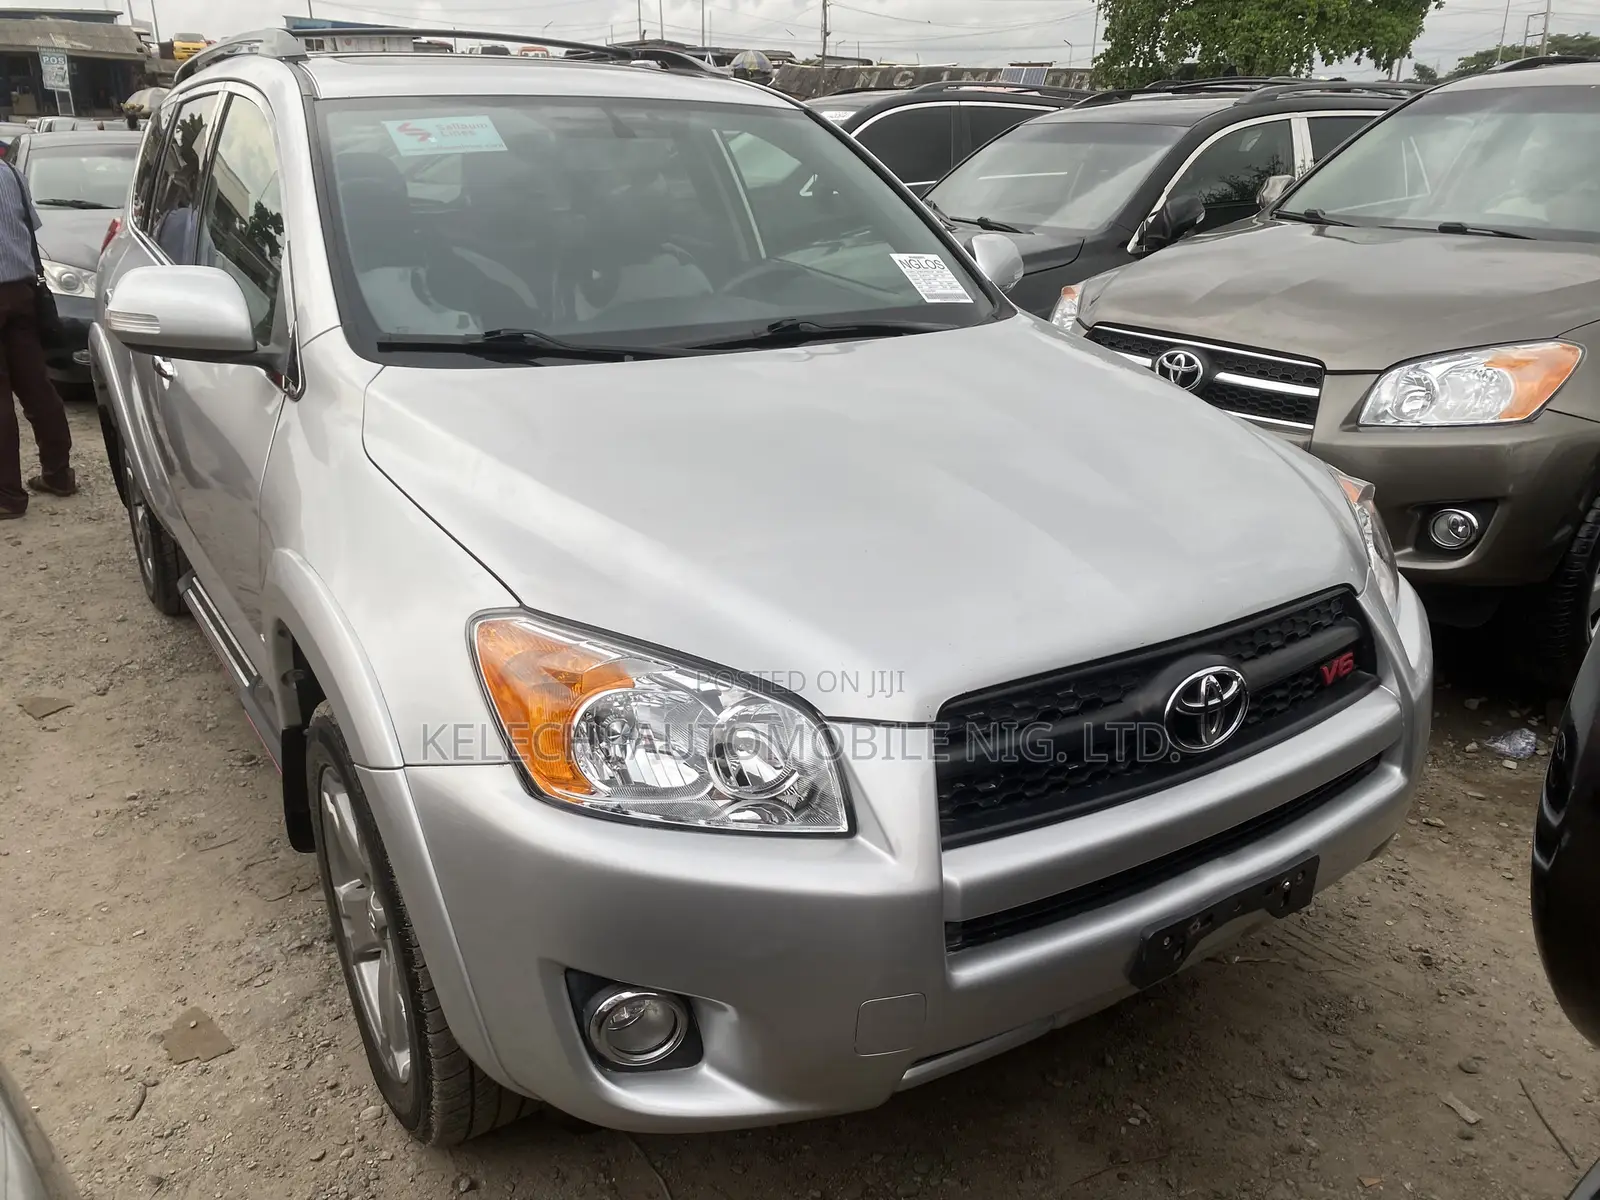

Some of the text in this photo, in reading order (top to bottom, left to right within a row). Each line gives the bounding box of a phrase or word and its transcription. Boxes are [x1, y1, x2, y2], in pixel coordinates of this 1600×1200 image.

[42, 56, 65, 65] POS
[898, 259, 946, 270] NGLOS
[1320, 651, 1354, 685] V6
